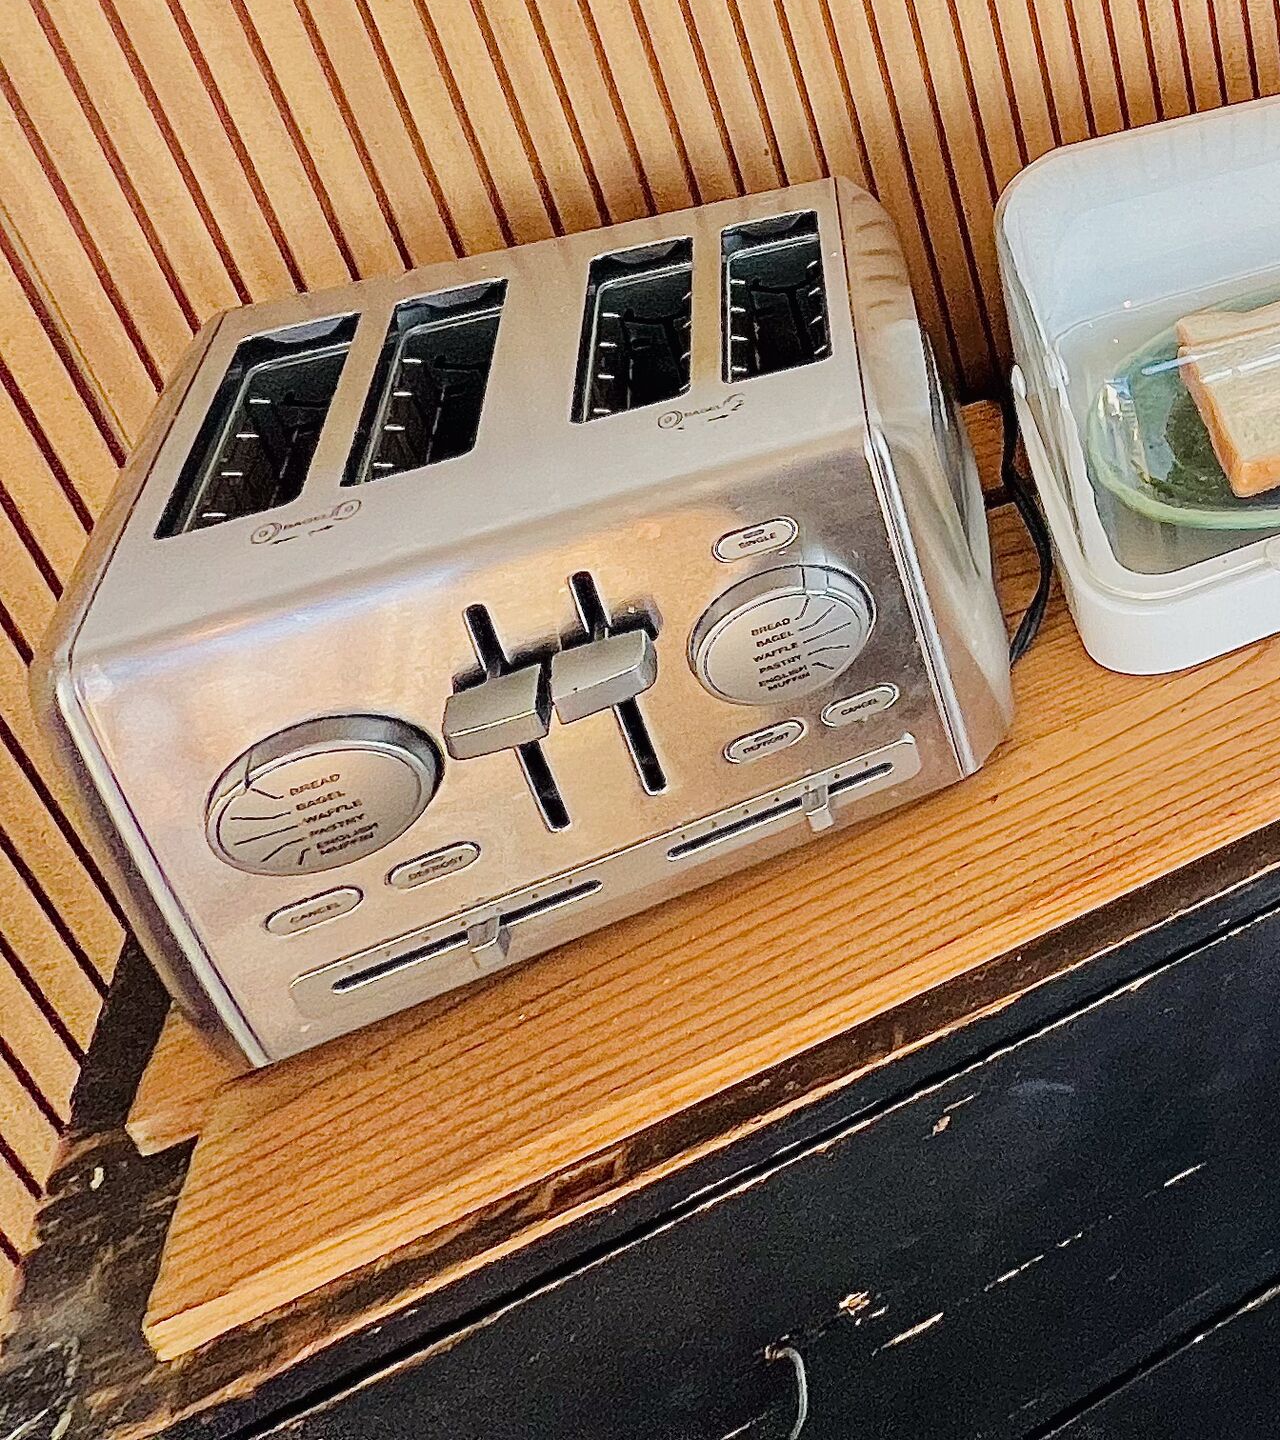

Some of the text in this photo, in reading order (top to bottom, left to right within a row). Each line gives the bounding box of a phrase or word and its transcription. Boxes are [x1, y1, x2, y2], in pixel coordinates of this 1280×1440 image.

[751, 617, 791, 636] BREAD
[756, 631, 794, 648] BAGEL
[753, 642, 798, 663] WAFFLE
[759, 654, 802, 674] PASTRY
[289, 773, 341, 796] BREAD
[295, 790, 346, 811] BAGEL
[302, 798, 363, 825] WAFFLE
[309, 812, 366, 836] PASTRY
